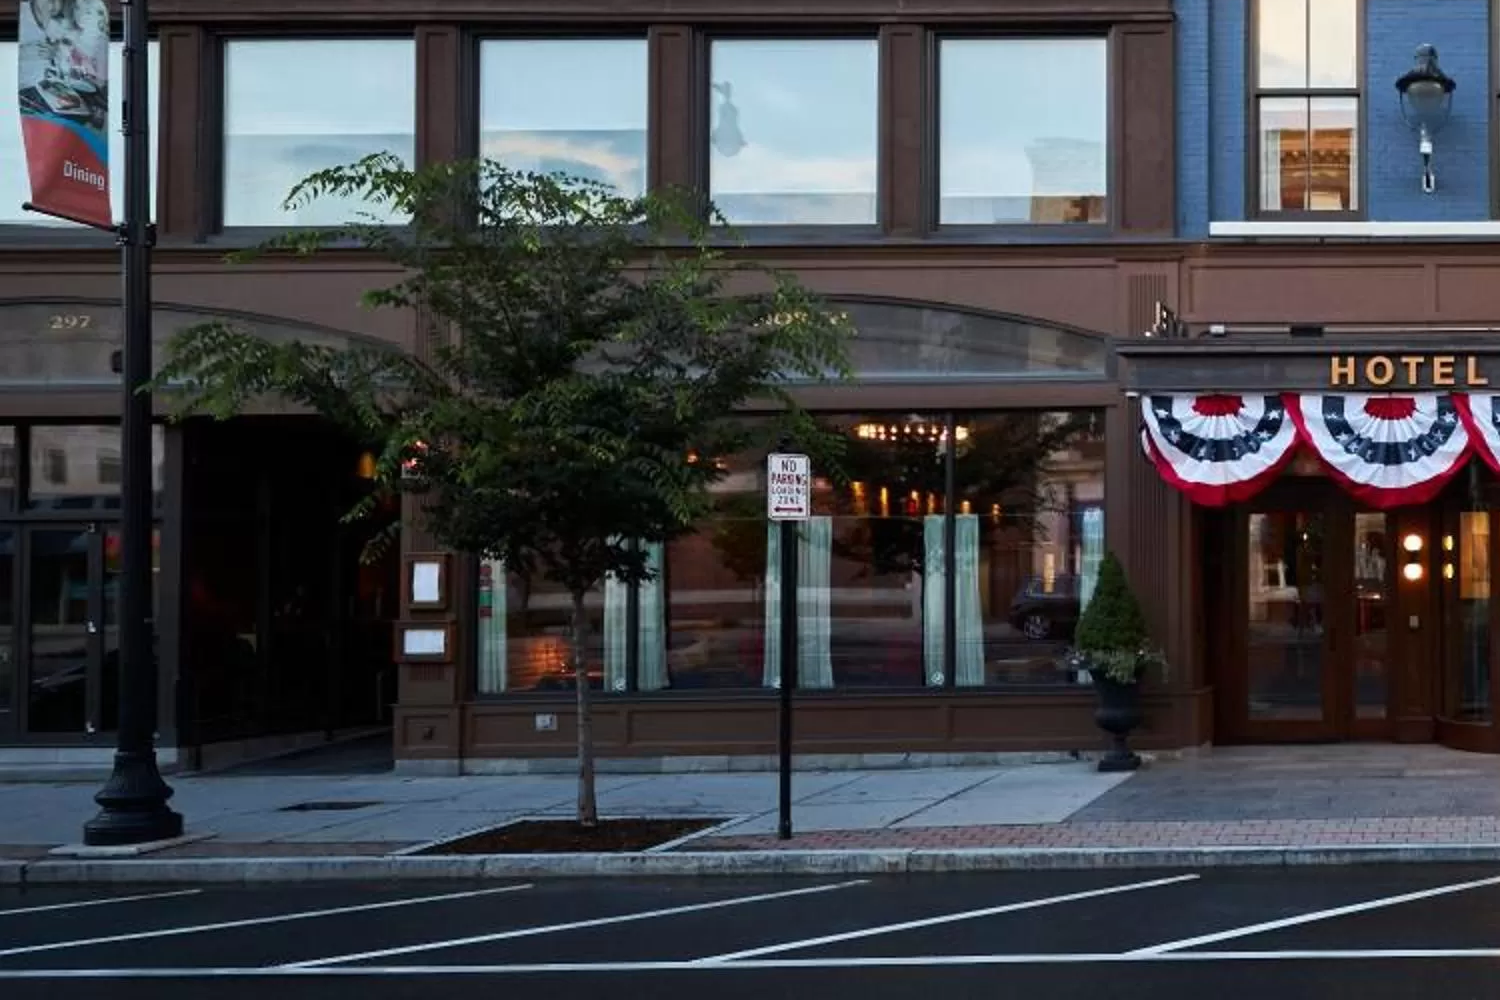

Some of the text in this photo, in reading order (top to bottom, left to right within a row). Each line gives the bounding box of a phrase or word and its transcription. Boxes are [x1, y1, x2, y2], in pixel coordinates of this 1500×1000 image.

[63, 159, 105, 190] Dining
[49, 315, 91, 329] 297
[1330, 355, 1489, 386] HOTEL
[781, 460, 797, 473] NO
[771, 473, 808, 485] PARKING
